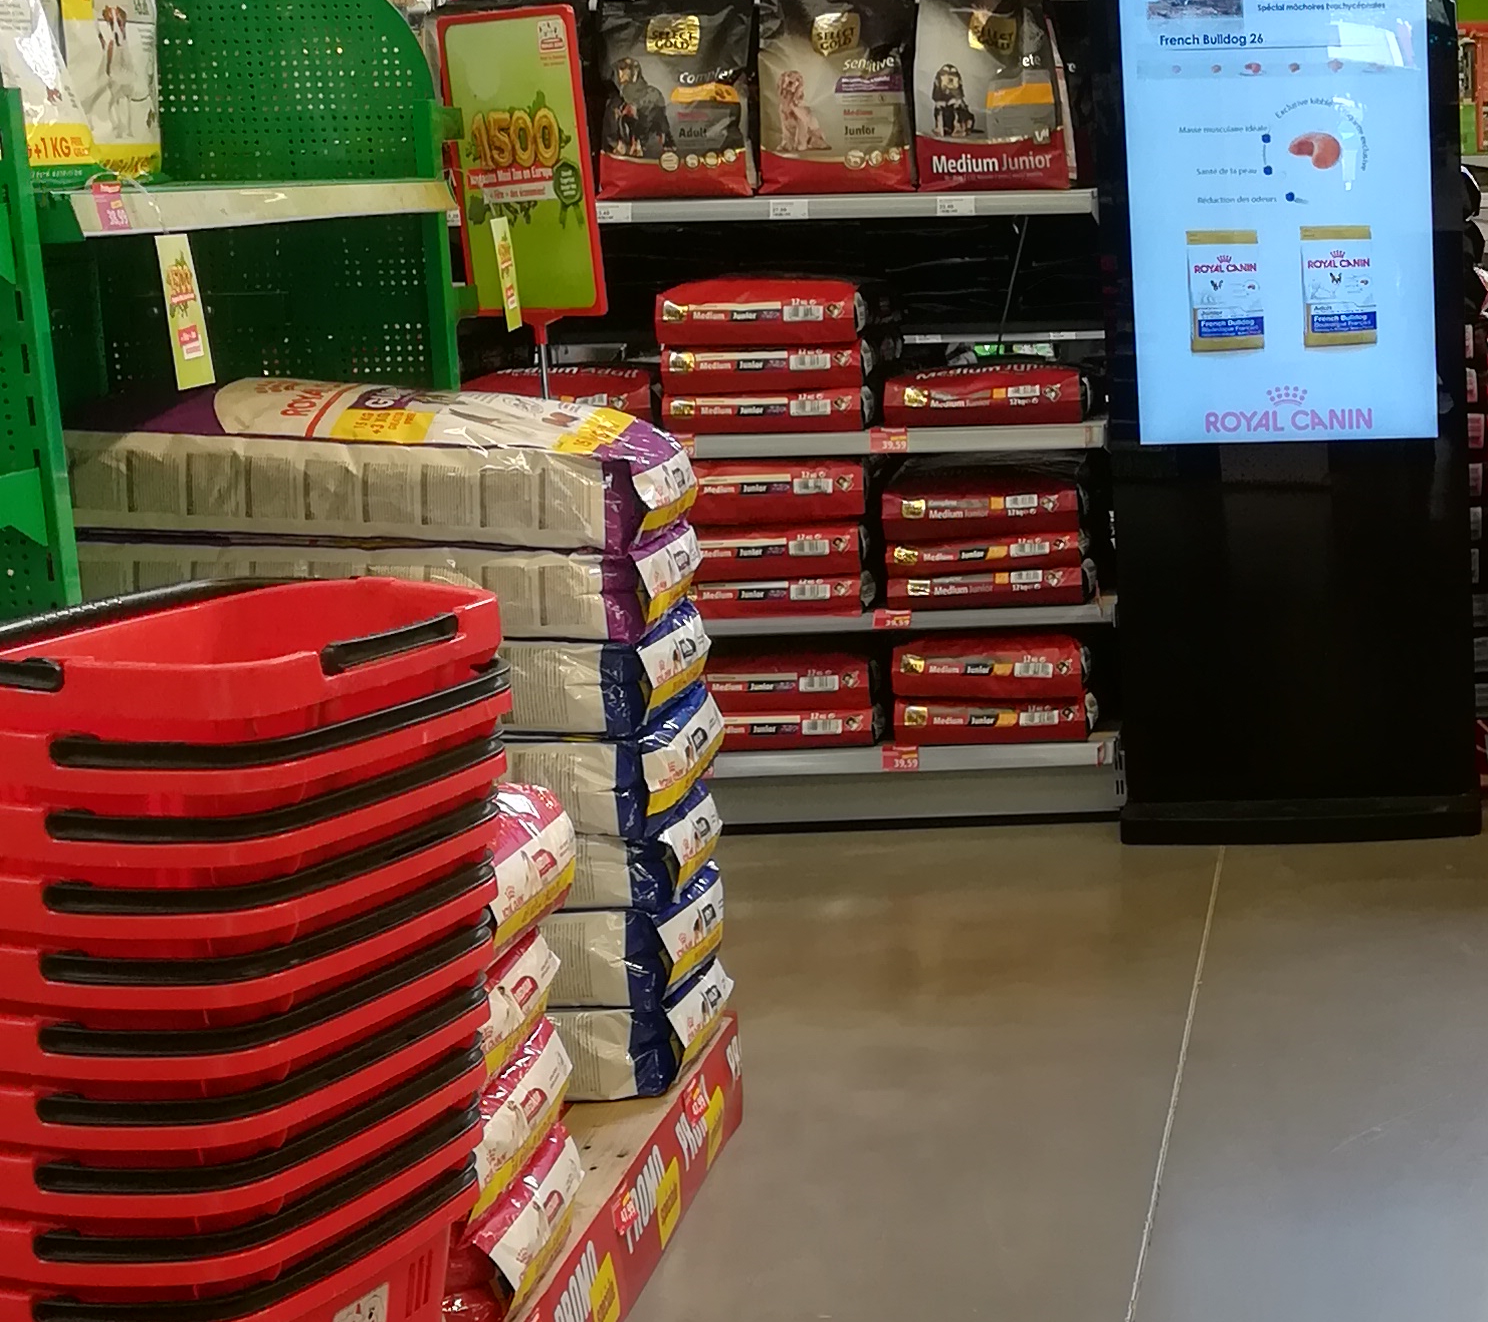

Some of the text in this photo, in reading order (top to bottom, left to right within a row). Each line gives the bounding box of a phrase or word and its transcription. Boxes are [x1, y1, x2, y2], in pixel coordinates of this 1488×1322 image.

[1257, 3, 1285, 12] Spécial
[652, 30, 695, 41] SELECT
[817, 26, 855, 41] SELECT
[655, 39, 690, 50] GOLD
[820, 37, 852, 51] GOLD
[1159, 33, 1264, 47] French Bulldog 26
[844, 125, 875, 136] Junior
[472, 108, 560, 169] 1500
[932, 151, 1052, 173] Medium Junior
[1197, 167, 1217, 175] Santé
[1239, 168, 1257, 176] peau
[1194, 263, 1257, 274] ROYAL CANIN
[1307, 258, 1370, 269] ROYAL CANIN
[693, 311, 757, 320] Medium Junior
[1314, 315, 1339, 323] French
[700, 361, 764, 370] Medium Junior
[930, 398, 990, 408] Medium Junior
[701, 407, 764, 415] Medium Junior
[1205, 407, 1373, 434] ROYAL CANIN
[882, 440, 907, 451] 39,59
[704, 484, 767, 494] Medium Junior
[929, 509, 988, 519] Medium Junior
[739, 549, 763, 557] Junior
[961, 551, 984, 560] Junior
[702, 590, 764, 600] Medium Junior
[934, 586, 969, 596] Medium
[929, 665, 990, 674] Medium Junior
[712, 683, 774, 691] Medium Junior
[933, 716, 995, 725] Medium Junior
[753, 725, 776, 733] Junior
[894, 759, 918, 768] 39,59
